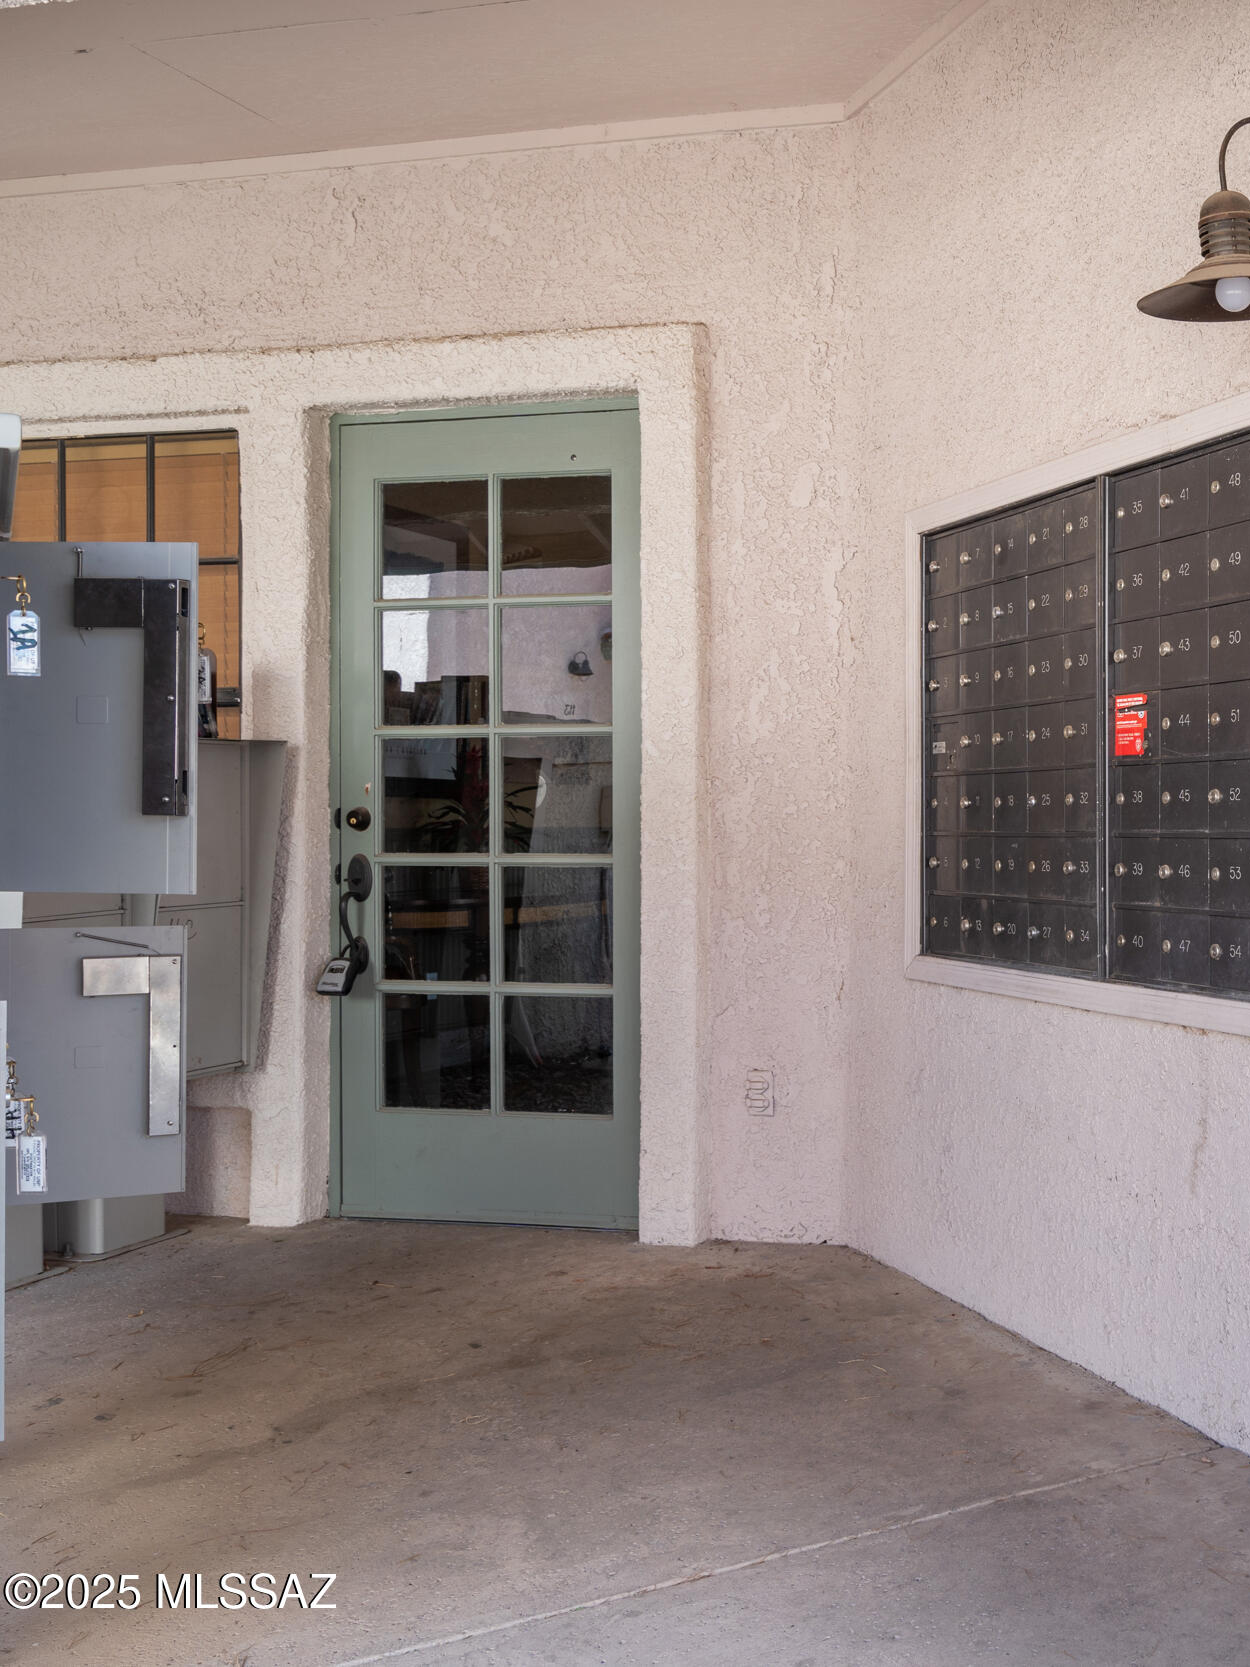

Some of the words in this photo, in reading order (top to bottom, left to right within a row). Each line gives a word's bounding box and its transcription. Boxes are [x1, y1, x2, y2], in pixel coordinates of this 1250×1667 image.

[1229, 473, 1240, 485] 48
[1180, 488, 1188, 499] 41
[1132, 501, 1142, 514] 35
[1080, 516, 1088, 528] 28
[1043, 528, 1049, 539] 21
[1229, 552, 1241, 564] 49
[1179, 563, 1189, 576] 42
[1133, 573, 1142, 586] 36
[1079, 585, 1088, 597] 29
[1042, 594, 1049, 606] 22
[1229, 630, 1241, 644] 50
[1179, 638, 1190, 650] 43
[1133, 646, 1142, 658] 37
[1079, 654, 1088, 666] 30
[1042, 661, 1050, 672] 23
[1179, 714, 1190, 726] 44
[1231, 709, 1239, 722] 51
[1042, 728, 1050, 739] 24
[1081, 723, 1087, 735] 31
[1042, 794, 1050, 805] 25
[1080, 792, 1088, 804] 32
[1133, 791, 1142, 802] 38
[1179, 790, 1190, 801] 45
[1230, 788, 1240, 800] 52
[1042, 861, 1050, 871] 26
[1080, 861, 1089, 872] 33
[1133, 863, 1143, 875] 39
[1179, 865, 1190, 877] 46
[1230, 866, 1241, 879] 53
[1008, 923, 1016, 934] 20
[1043, 927, 1051, 938] 27
[1081, 930, 1089, 941] 34
[1133, 936, 1143, 947] 40
[1180, 940, 1190, 952] 47
[1230, 945, 1241, 958] 54
